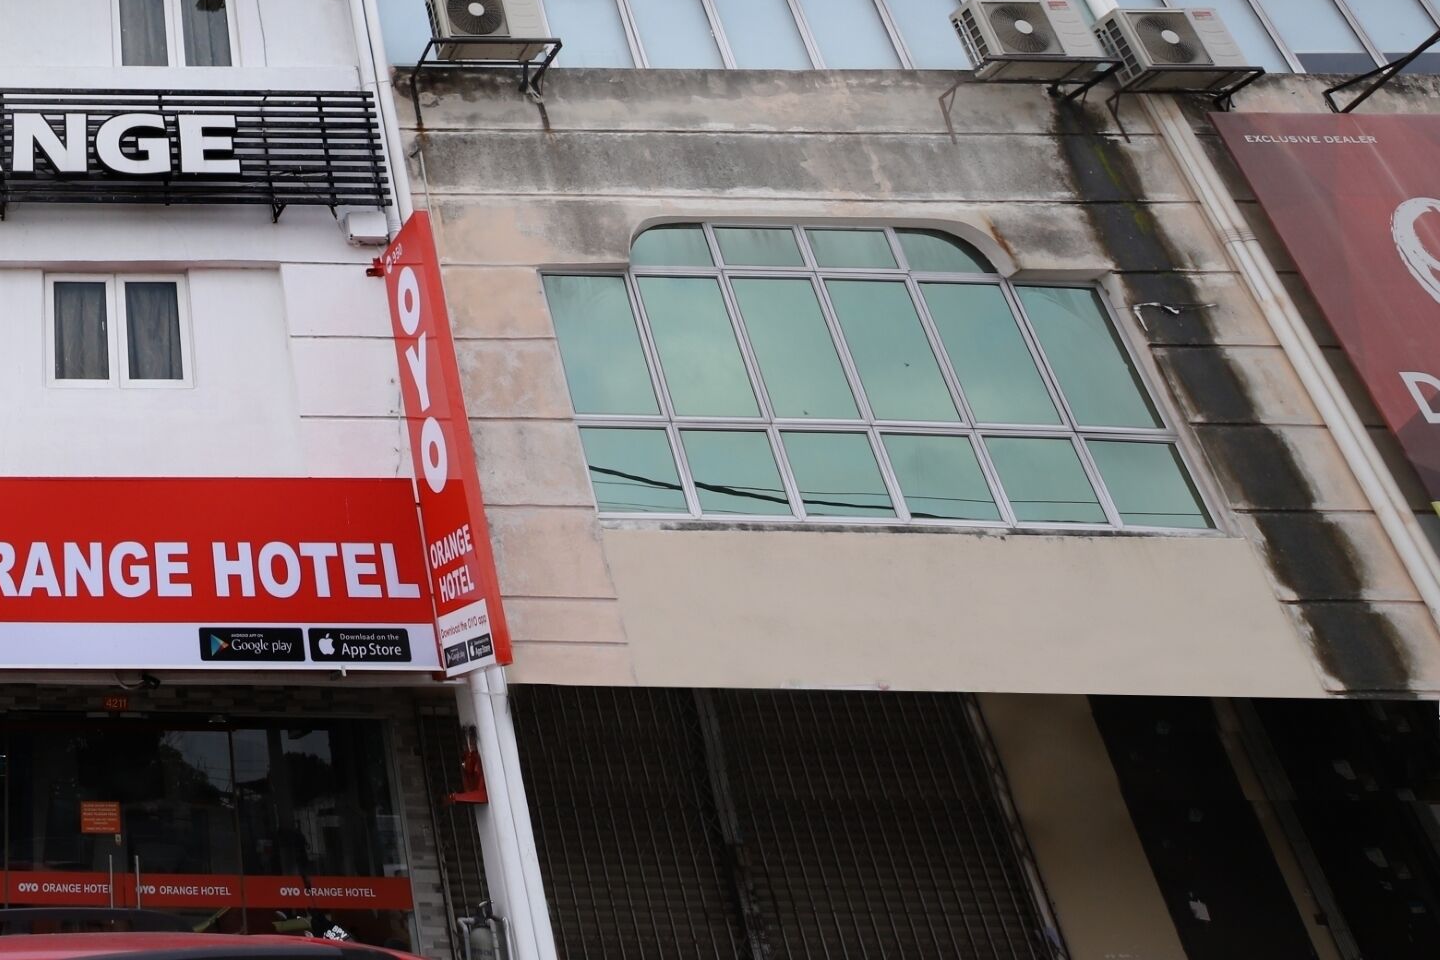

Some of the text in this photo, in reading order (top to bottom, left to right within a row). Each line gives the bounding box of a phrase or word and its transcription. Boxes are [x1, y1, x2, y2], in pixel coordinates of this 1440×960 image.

[1244, 135, 1378, 144] EXCLUSIVE DEALER
[397, 266, 448, 493] OYO
[430, 524, 472, 569] ORANGE
[212, 541, 420, 598] HOTEL
[439, 565, 475, 603] HOTEL
[231, 639, 293, 654] Google play
[342, 643, 402, 658] App Store
[106, 697, 127, 709] 4211
[19, 882, 39, 892] OYO
[42, 883, 81, 893] ORANGE
[159, 885, 199, 895] ORANGE
[201, 886, 232, 895] HOTEL
[280, 887, 300, 896] OYO
[345, 888, 376, 897] HOTEL
